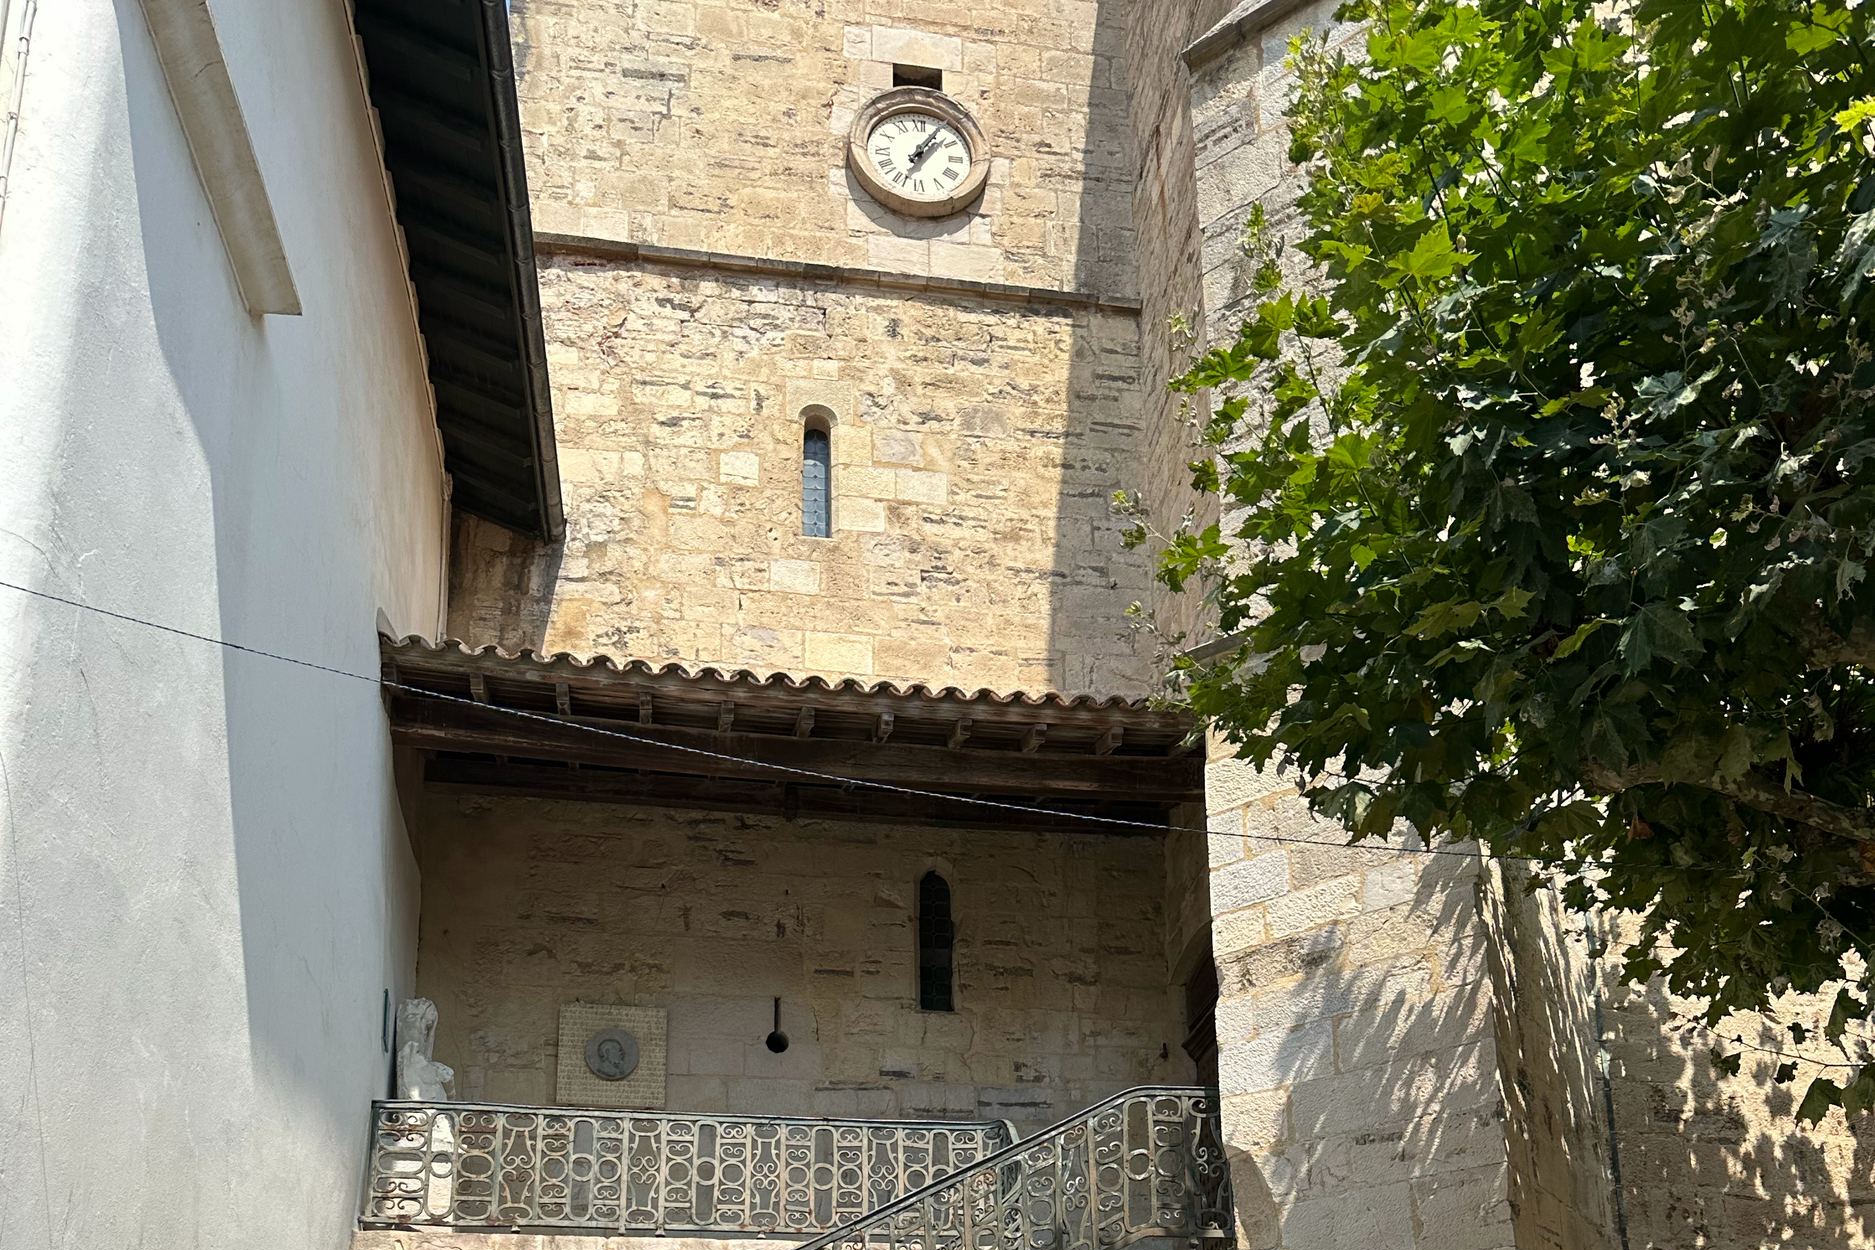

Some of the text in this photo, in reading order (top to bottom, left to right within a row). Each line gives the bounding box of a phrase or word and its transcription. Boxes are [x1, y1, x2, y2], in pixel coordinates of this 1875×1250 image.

[893, 120, 909, 134] XI
[912, 119, 926, 132] XII
[879, 130, 895, 143] X
[875, 145, 891, 156] IX
[943, 140, 958, 149] II
[948, 155, 963, 165] III
[913, 179, 925, 192] VI
[933, 178, 945, 190] V
